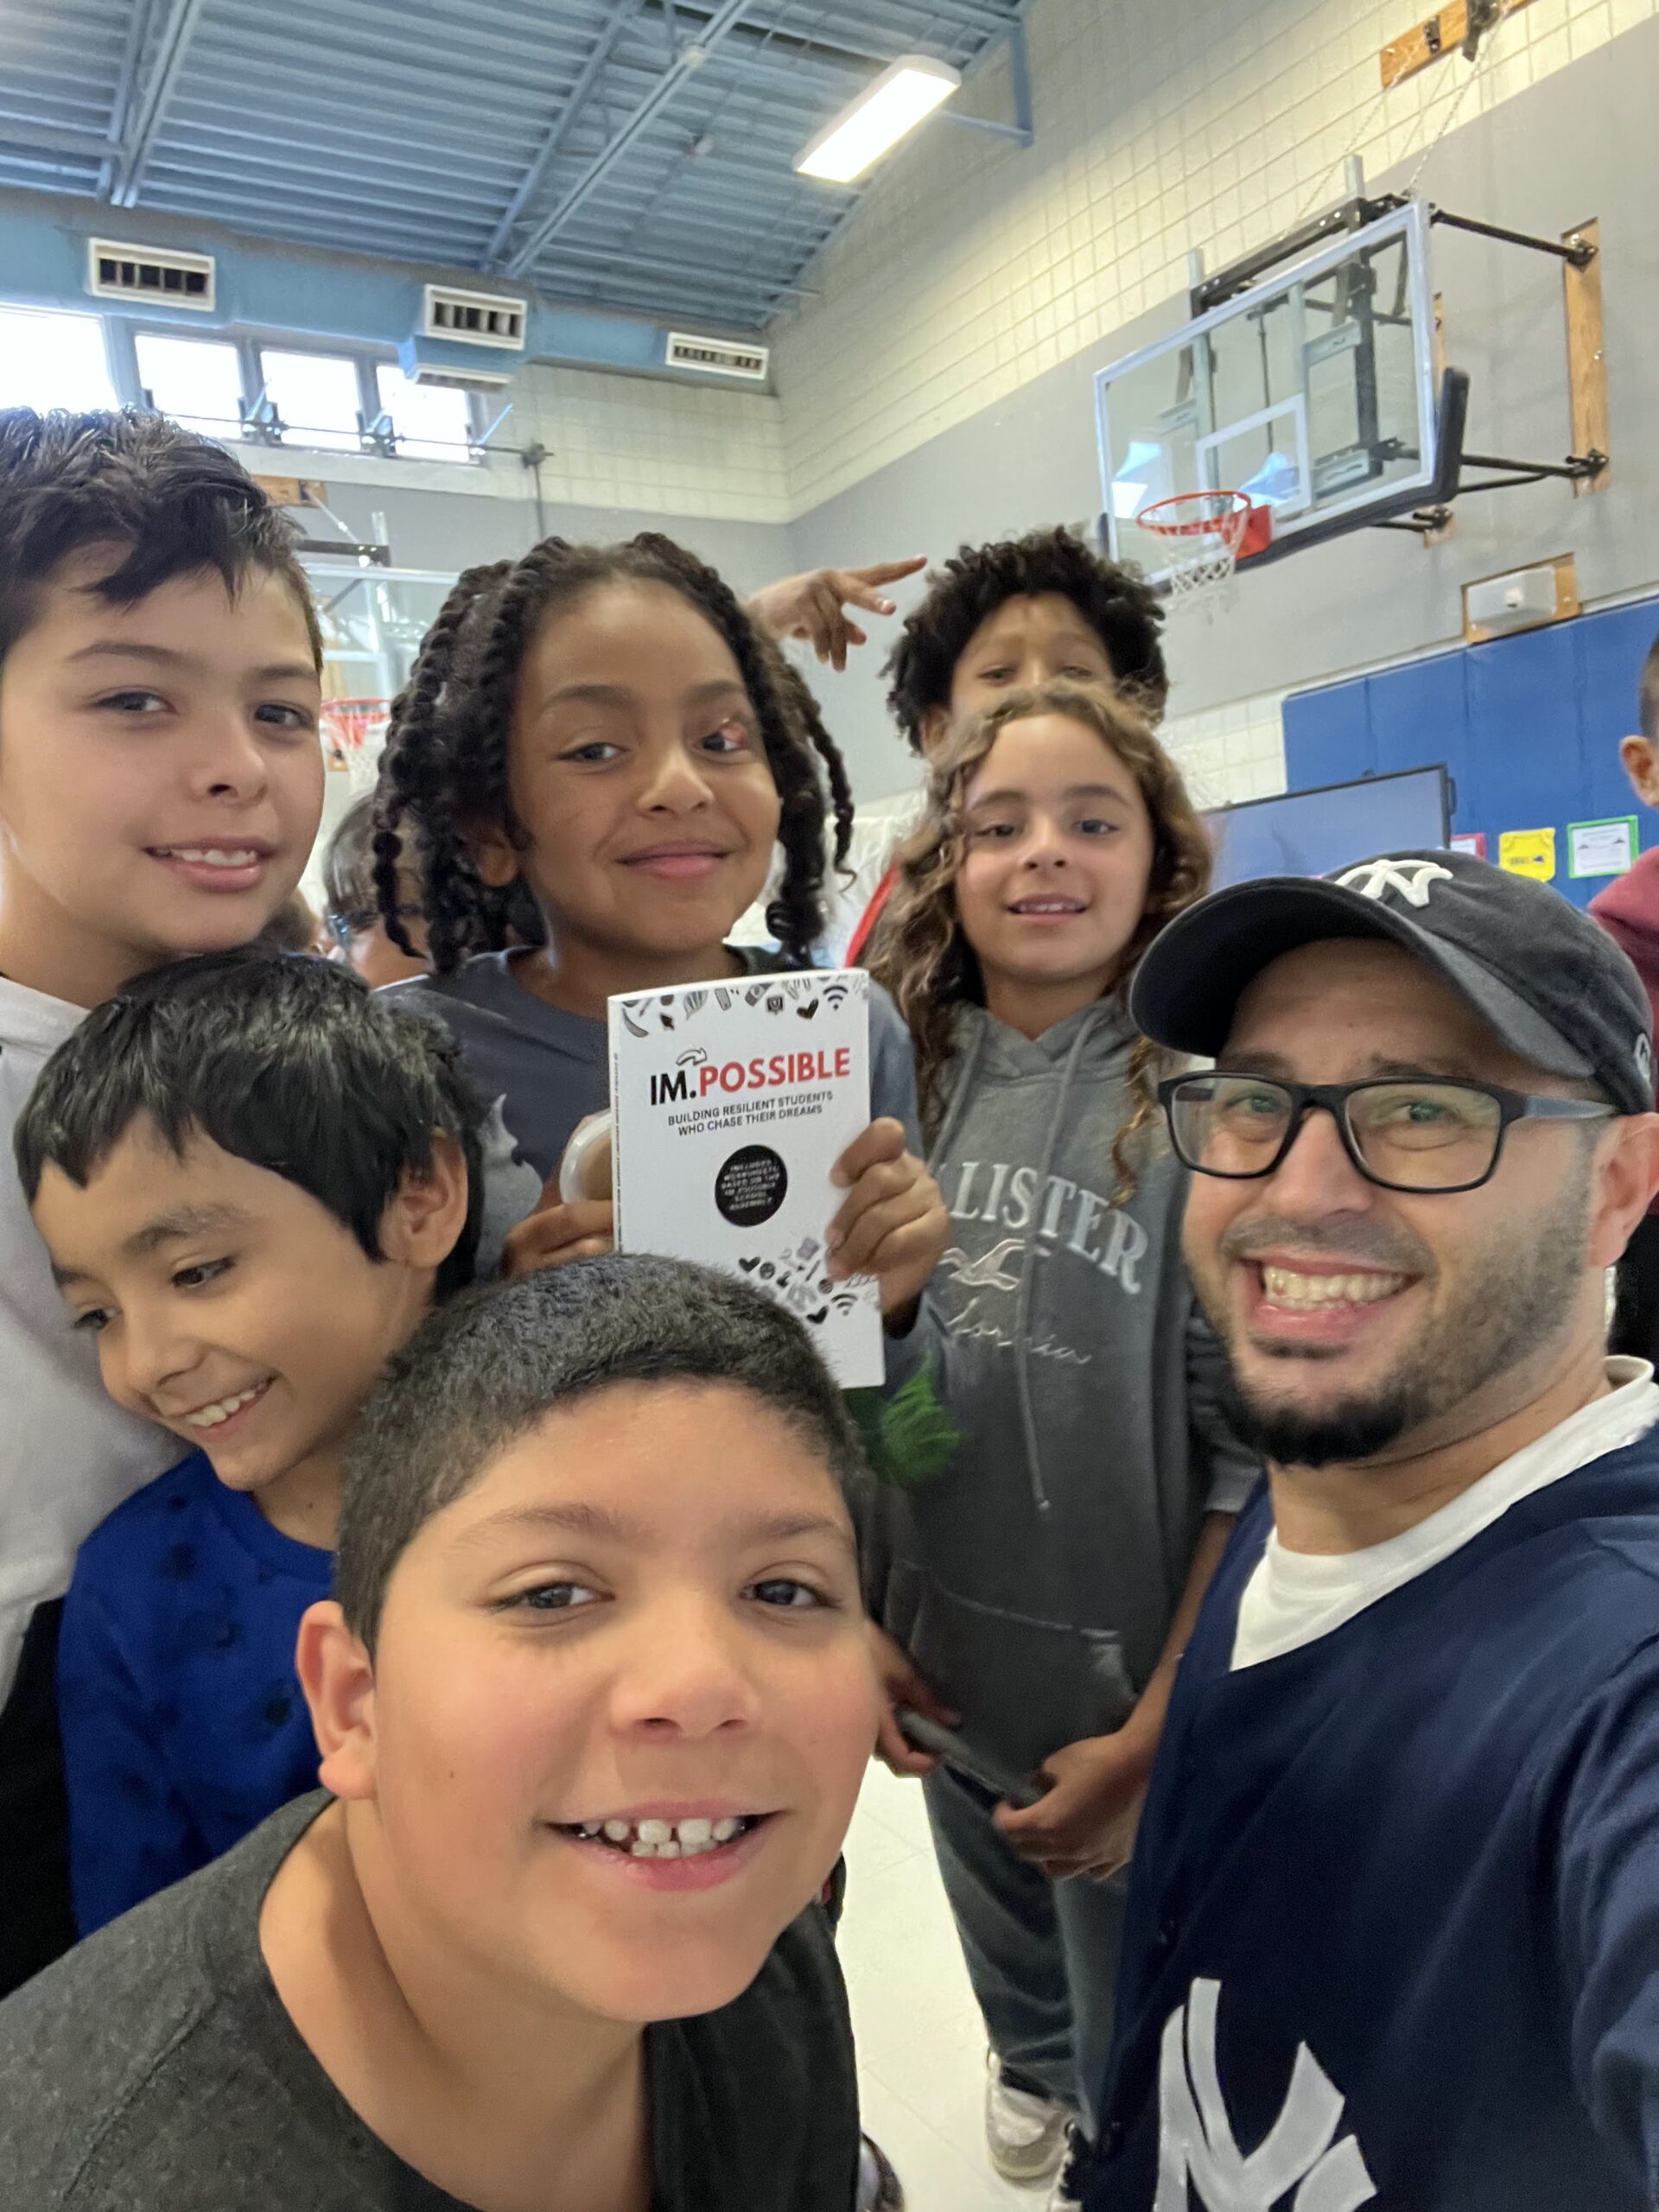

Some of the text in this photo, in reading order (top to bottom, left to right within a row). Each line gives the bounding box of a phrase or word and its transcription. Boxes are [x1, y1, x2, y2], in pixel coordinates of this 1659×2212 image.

[650, 1047, 850, 1106] IM.POSSIBLE
[668, 1090, 834, 1127] BUILDING RESILIENT STUDENTS
[678, 1104, 823, 1137] WHO CHASE THEIR DREAMS
[939, 1161, 1148, 1294] LISTER
